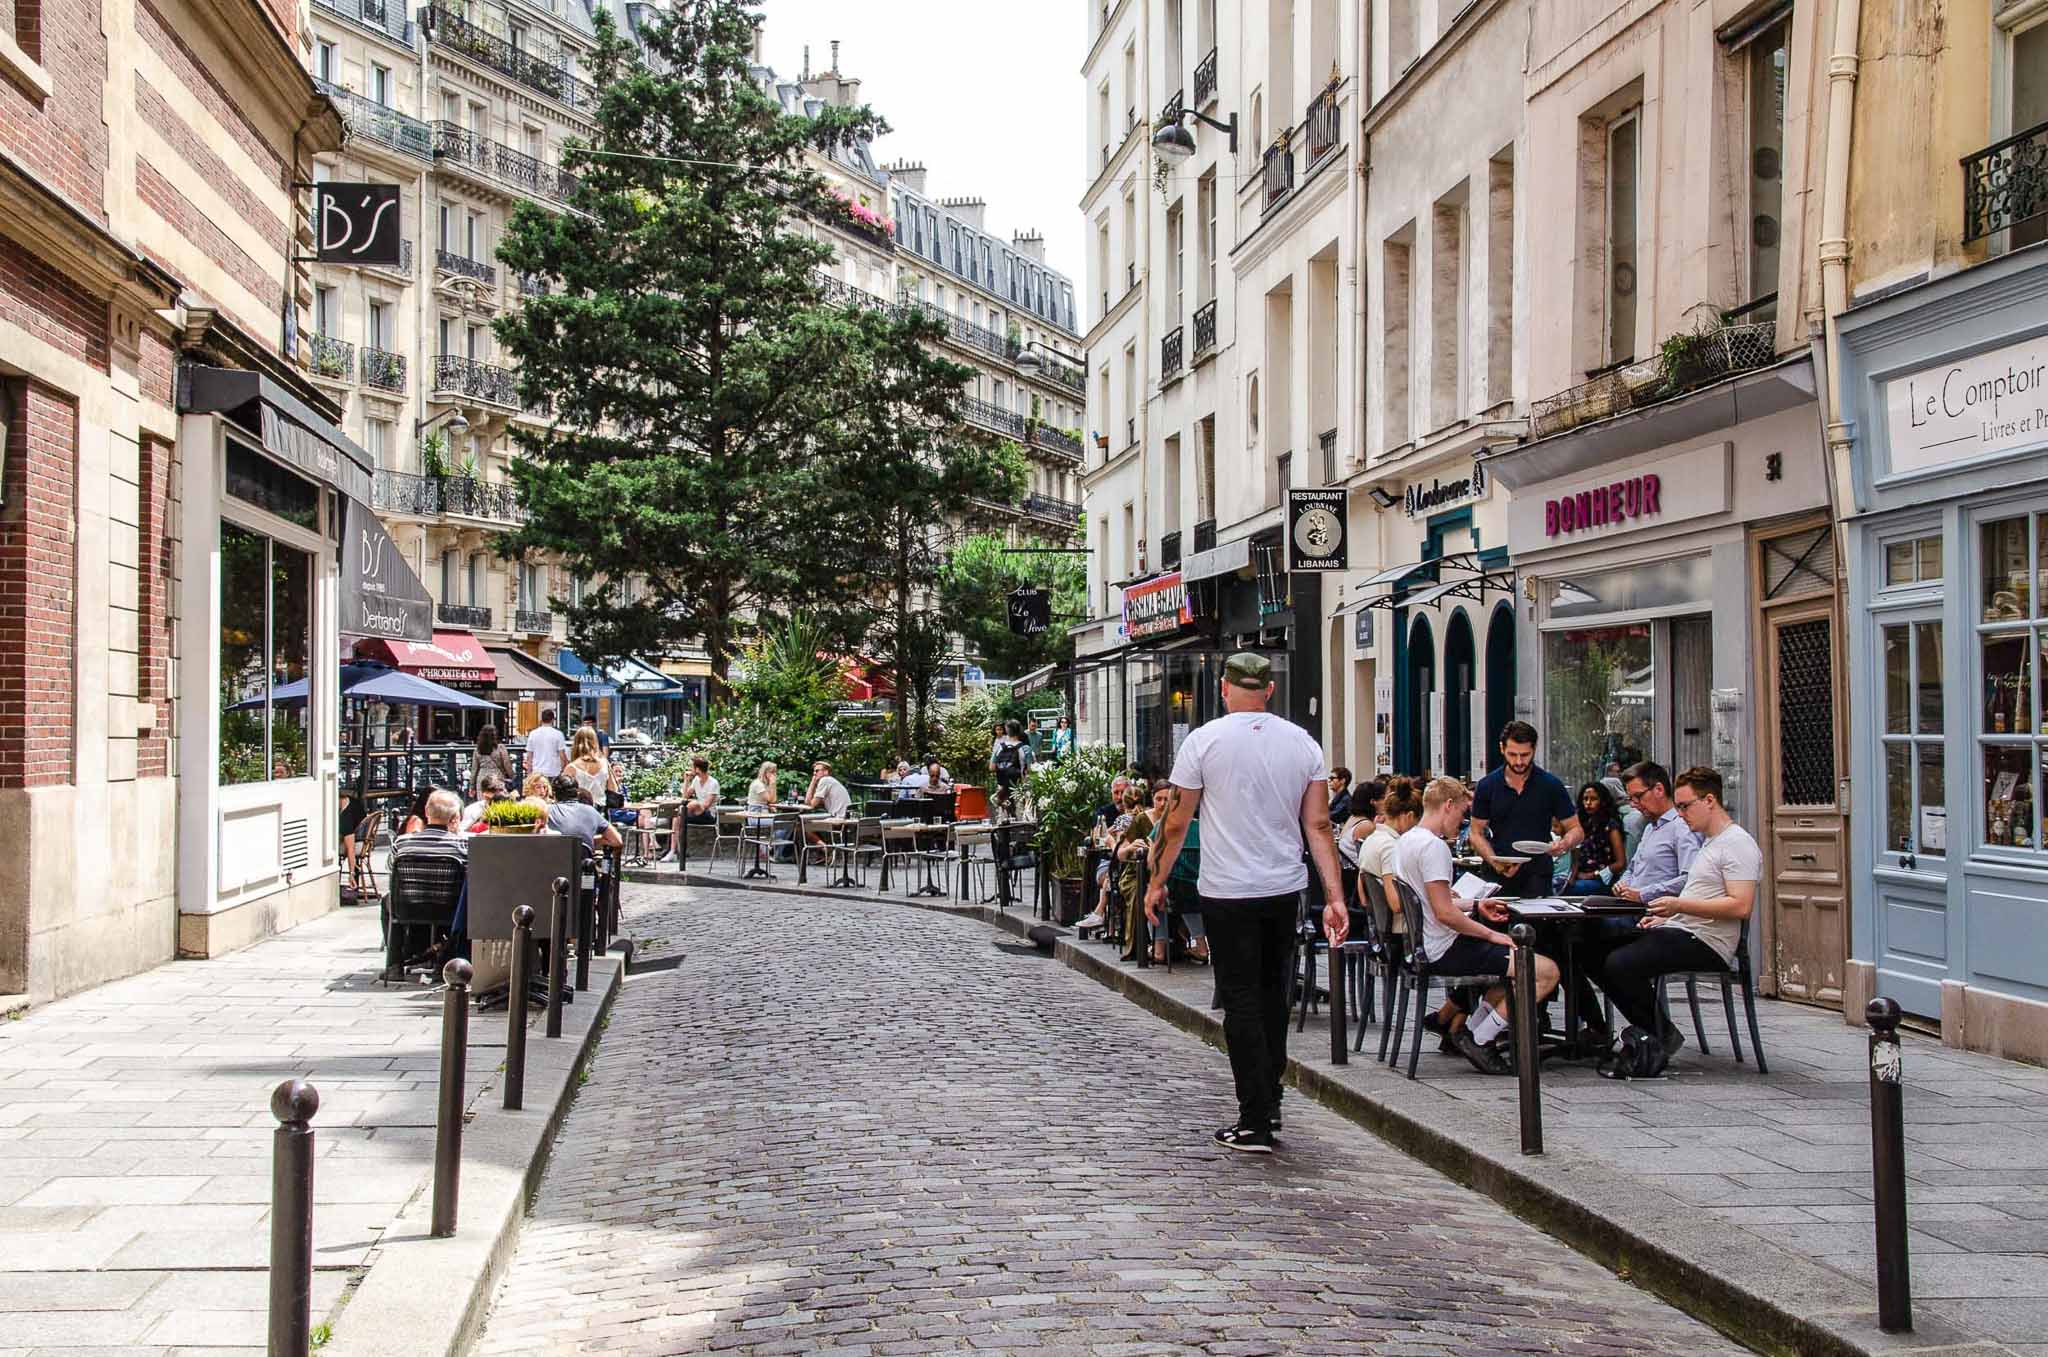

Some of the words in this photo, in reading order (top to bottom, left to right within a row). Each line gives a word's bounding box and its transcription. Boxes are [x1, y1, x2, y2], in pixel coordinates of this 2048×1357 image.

[1910, 381, 1937, 428] Le
[1943, 354, 2045, 419] Comptoir
[1982, 420, 2016, 442] Livres
[2020, 416, 2031, 432] et
[1291, 492, 1344, 500] RESTAURANT
[1546, 473, 1661, 537] BONHEUR
[1298, 560, 1339, 568] LIBANAIS
